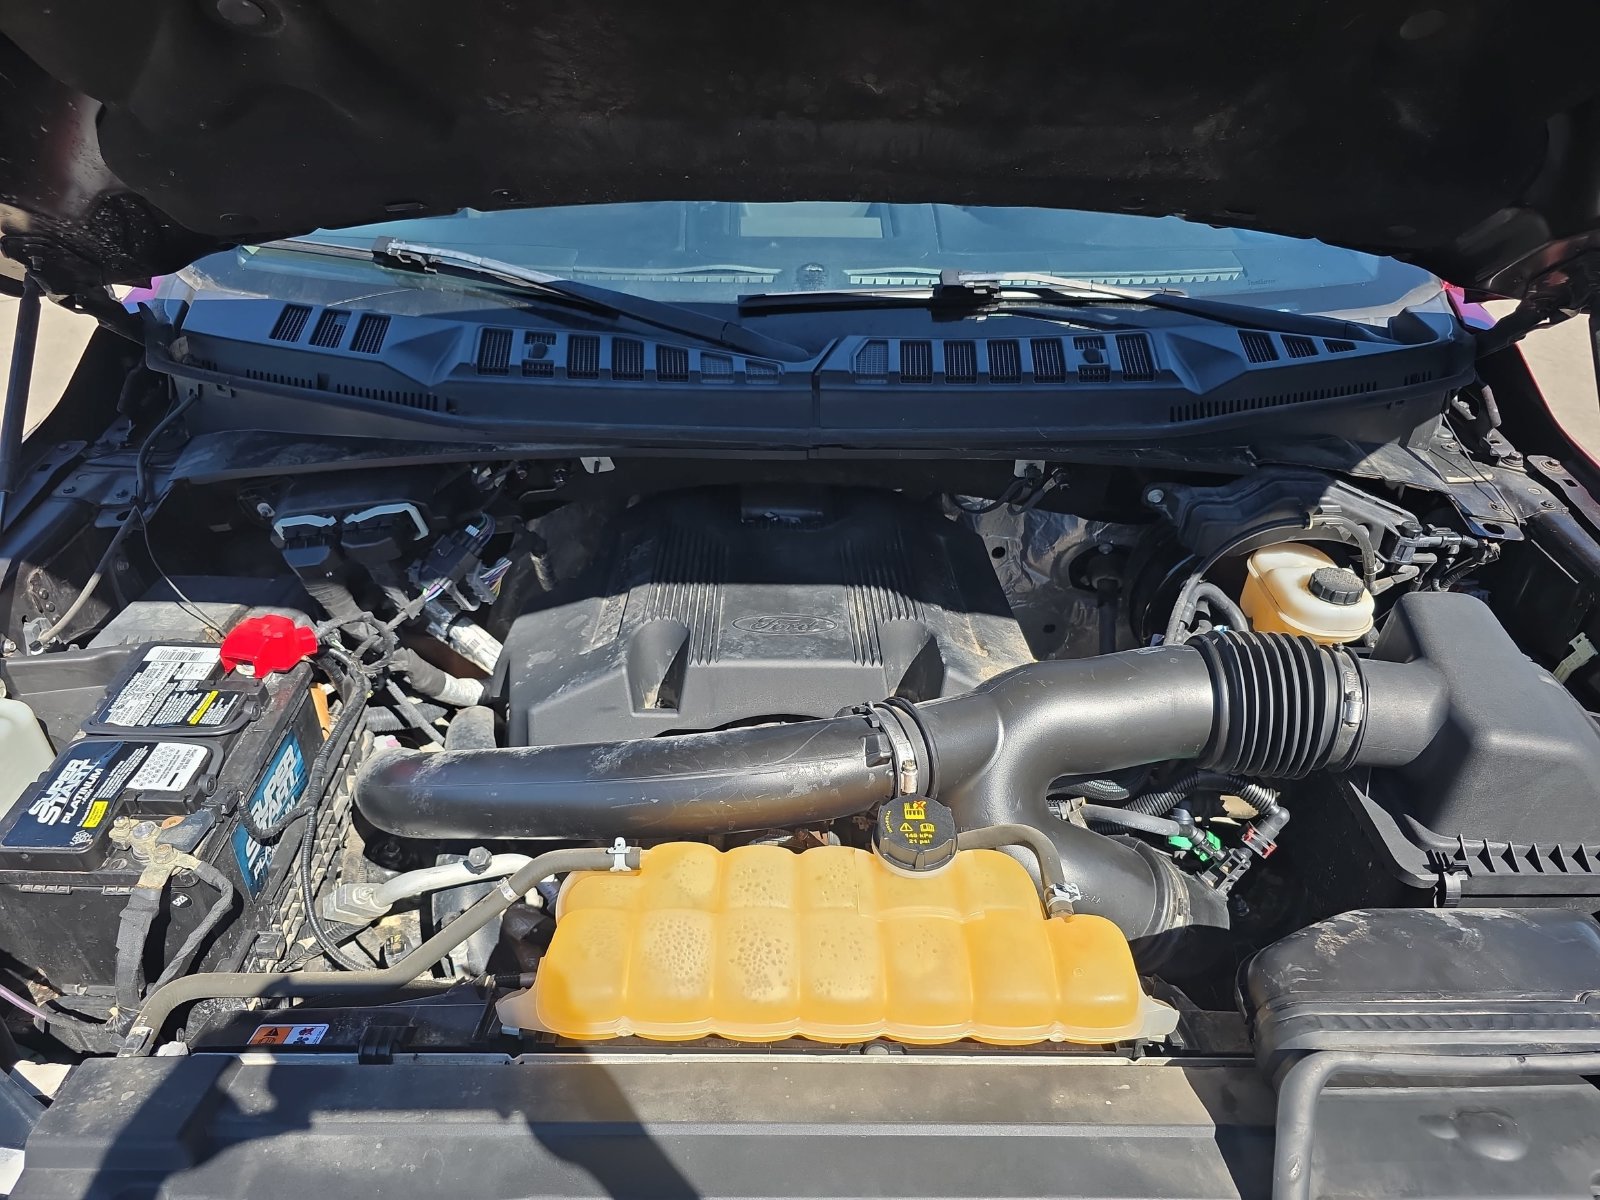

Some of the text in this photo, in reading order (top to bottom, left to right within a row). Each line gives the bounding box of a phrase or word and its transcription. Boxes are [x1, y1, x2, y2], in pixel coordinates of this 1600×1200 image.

[751, 616, 819, 631] Ford
[28, 759, 84, 815] SUPER
[37, 759, 92, 826] START
[60, 768, 105, 825] PLATINUM
[172, 895, 188, 907] 5/23
